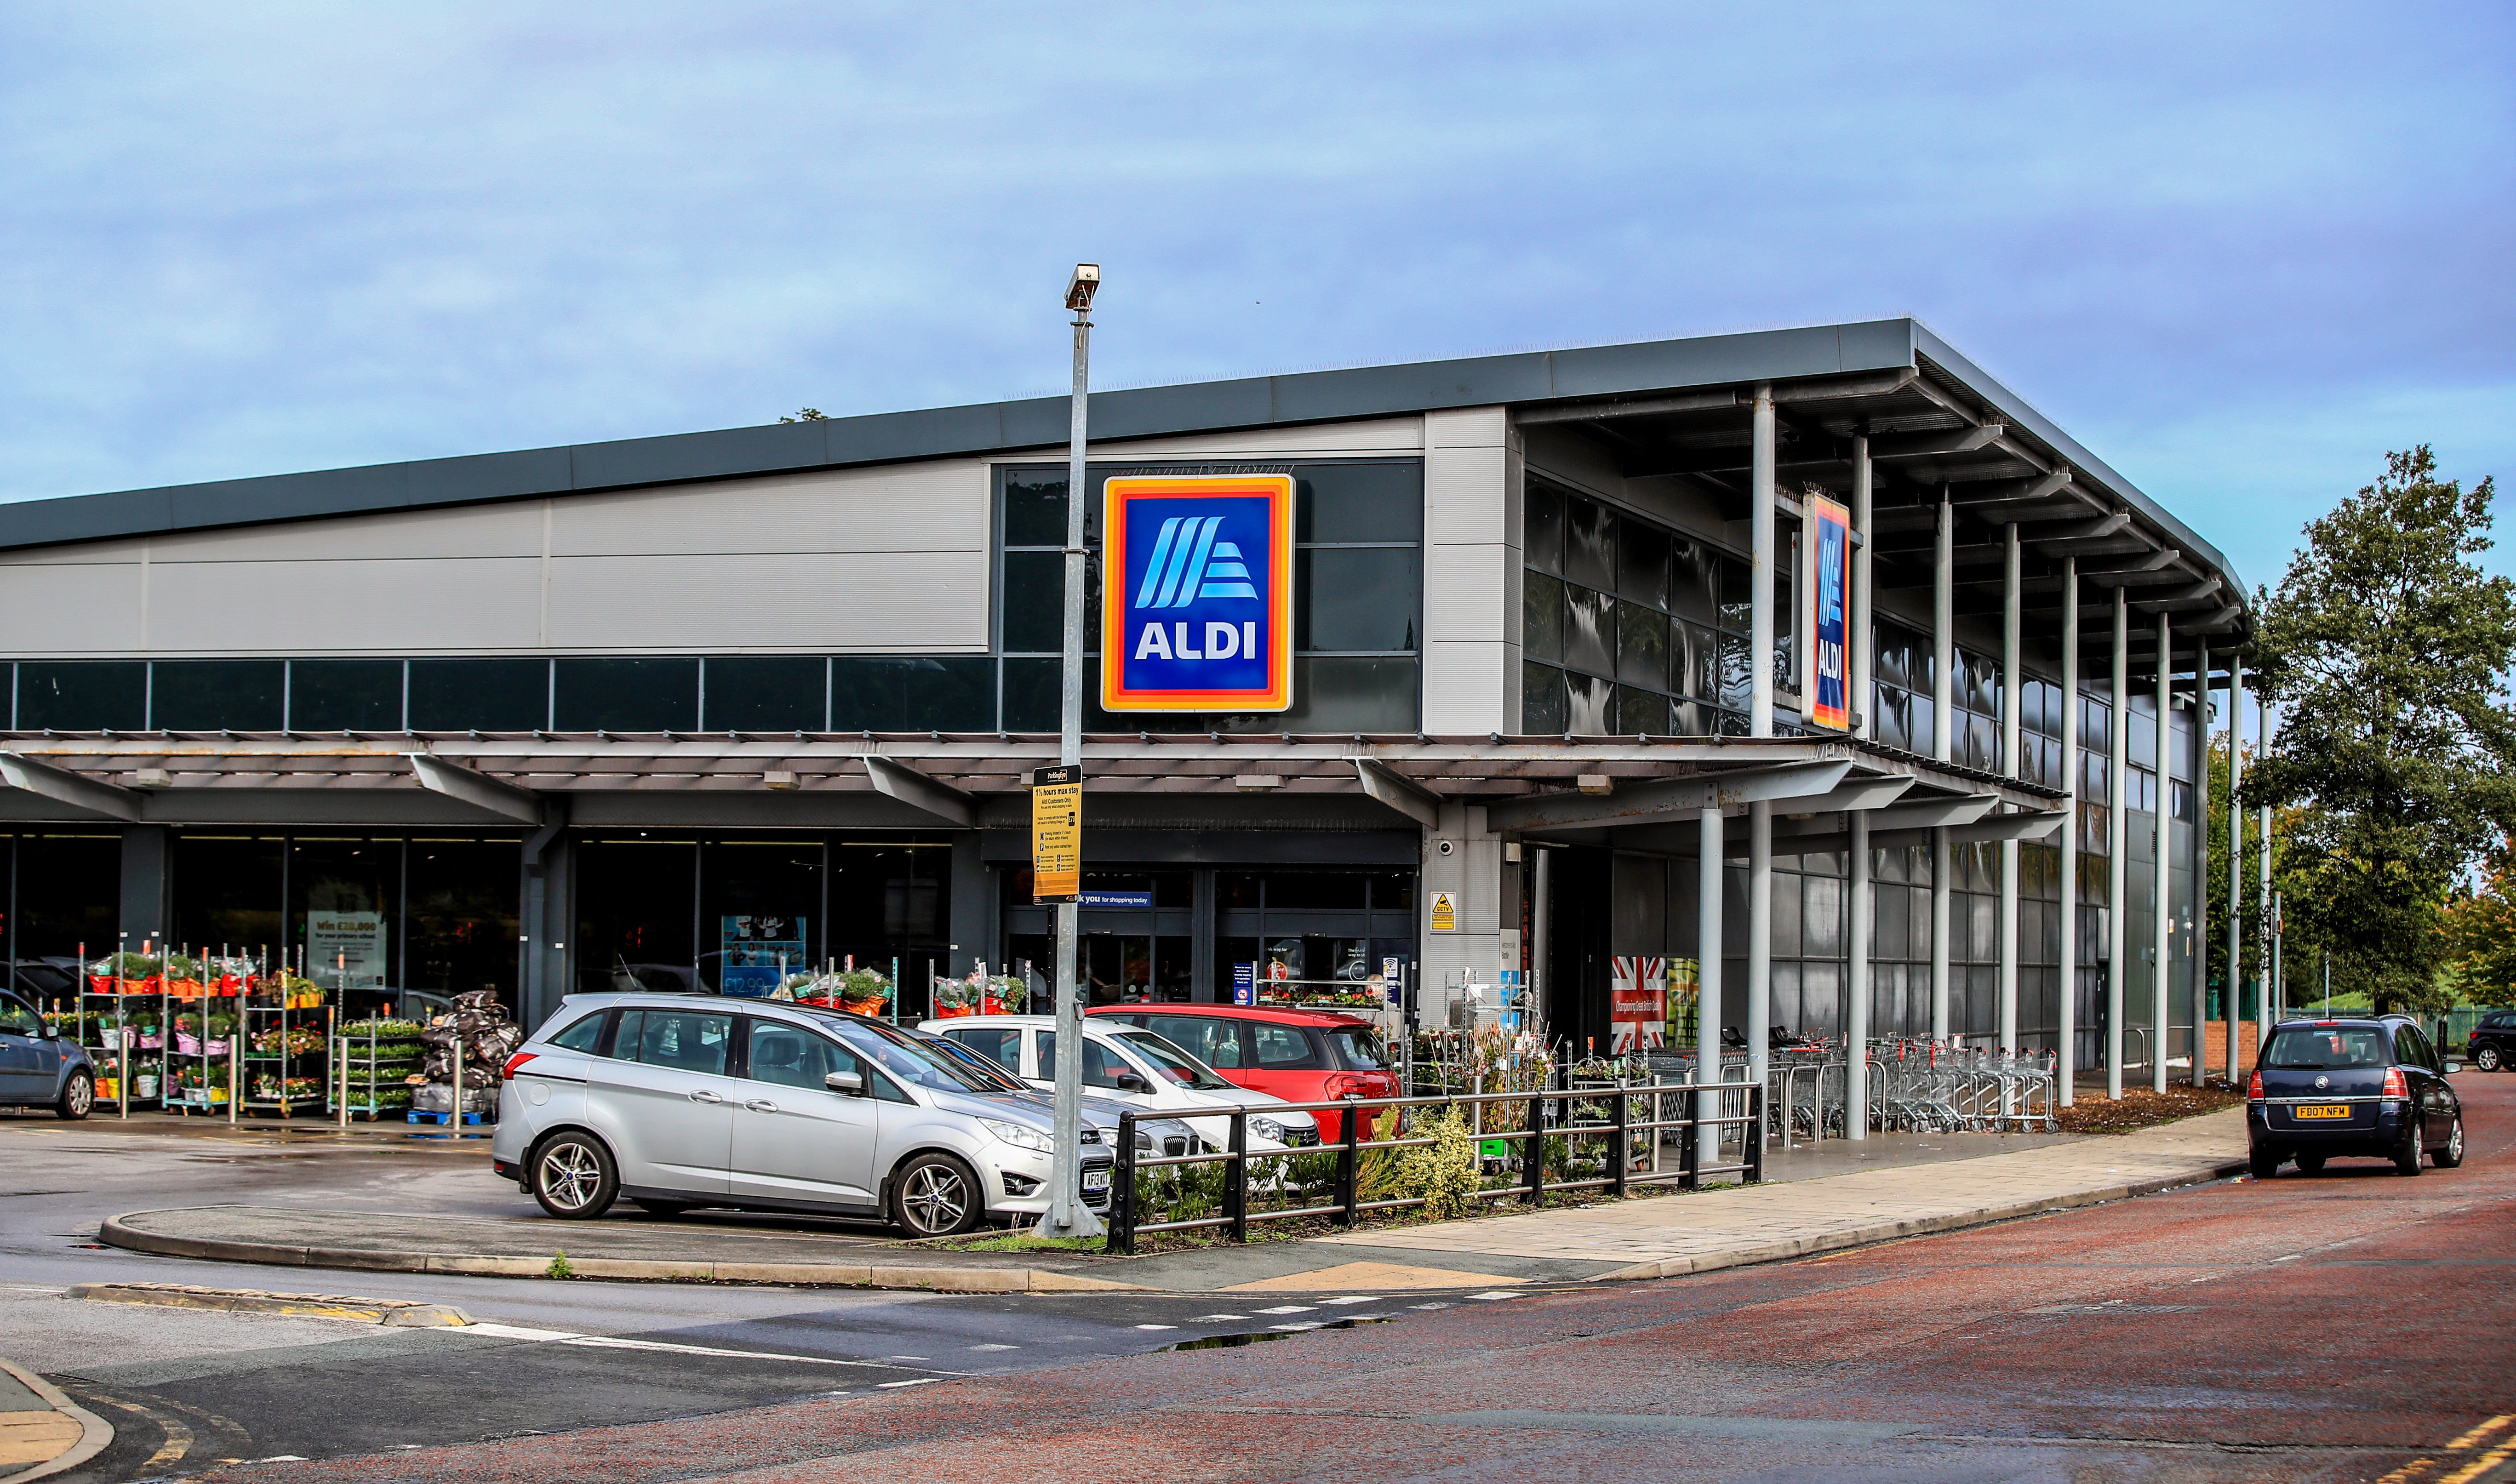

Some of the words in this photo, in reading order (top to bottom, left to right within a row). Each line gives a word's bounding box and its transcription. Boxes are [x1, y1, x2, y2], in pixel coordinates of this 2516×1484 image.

[1134, 621, 1256, 660] ALDI
[1818, 638, 1842, 681] ALDI
[1047, 771, 1066, 780] ParkingEye
[1069, 786, 1079, 795] stay
[317, 920, 335, 930] Win
[724, 978, 765, 993] £12.99
[1616, 999, 1636, 1015] Championing
[1643, 999, 1652, 1011] British
[1652, 999, 1662, 1014] Quality
[2327, 1107, 2344, 1116] NFM
